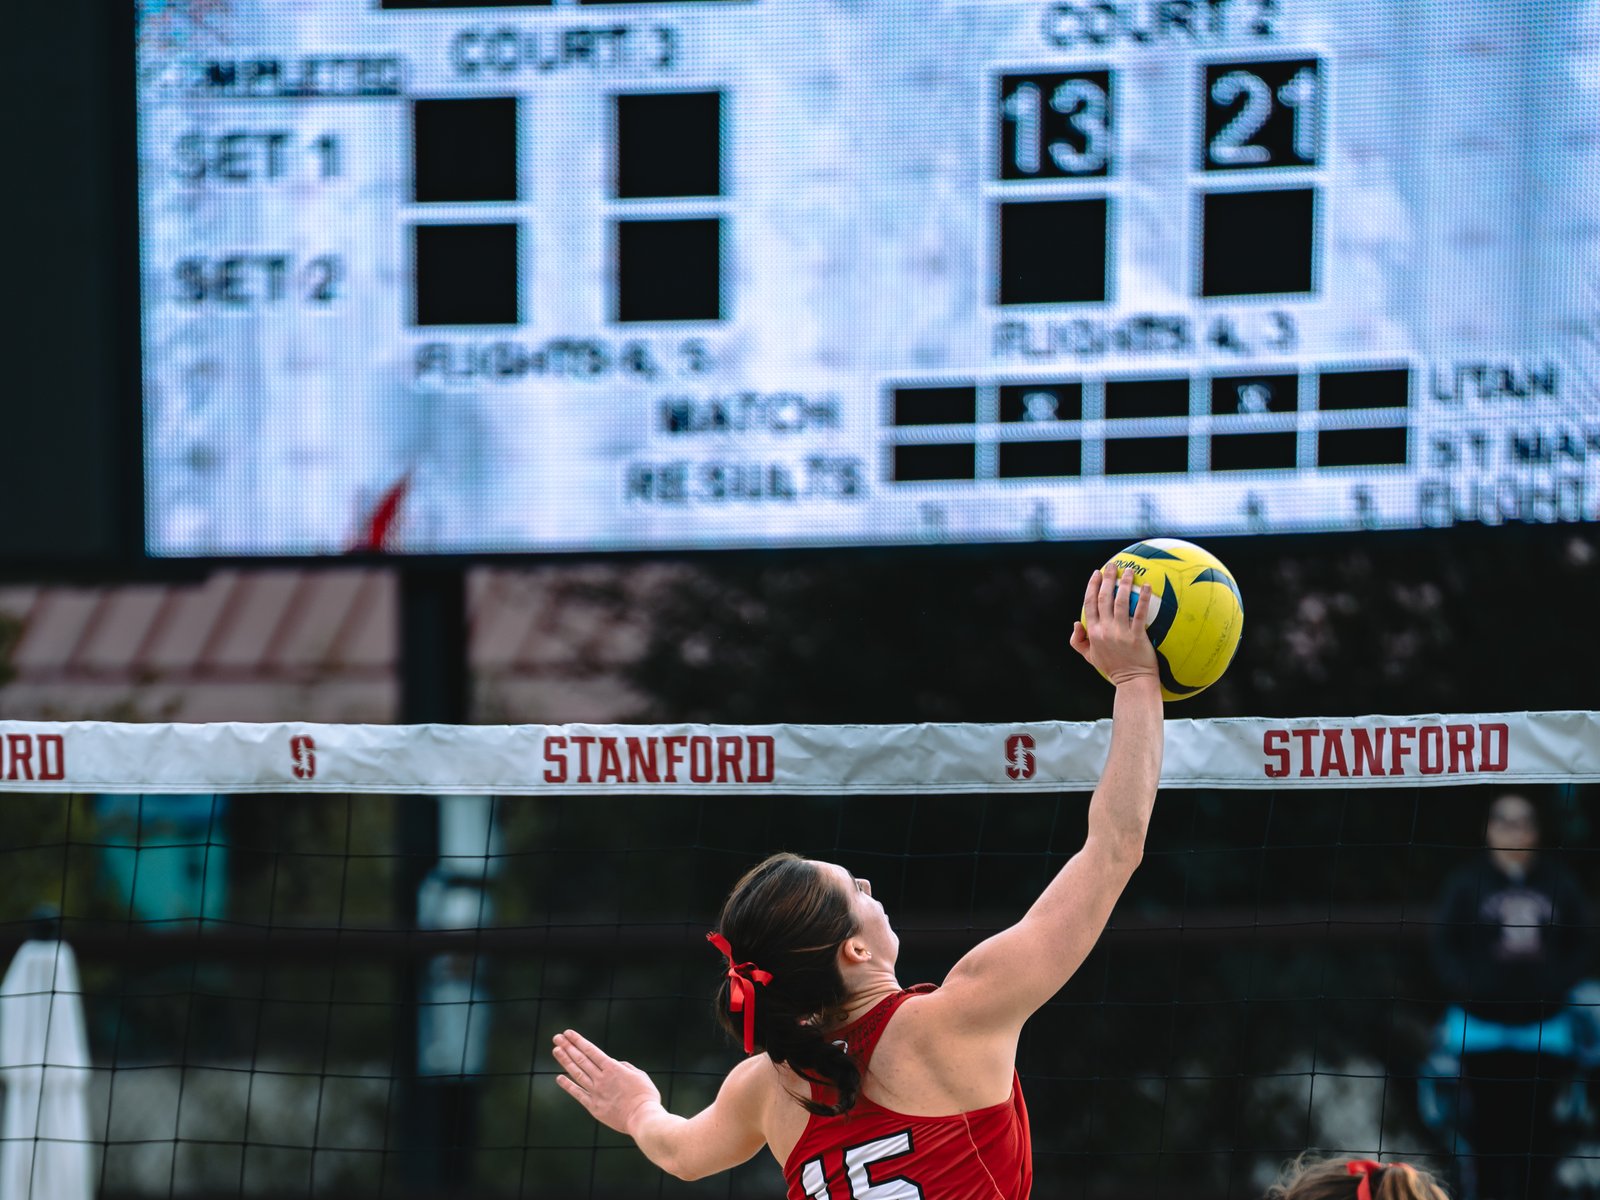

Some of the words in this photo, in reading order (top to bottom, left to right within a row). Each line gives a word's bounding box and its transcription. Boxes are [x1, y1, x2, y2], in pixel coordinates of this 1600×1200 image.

[1042, 0, 1220, 46] COURT
[451, 25, 628, 74] COURT
[1003, 78, 1110, 174] 13
[1208, 67, 1318, 165] 21
[173, 131, 292, 181] SET
[173, 253, 288, 304] SET
[304, 252, 341, 302] 2
[664, 392, 840, 433] MATCH
[542, 734, 776, 784] STANFORD
[1262, 721, 1511, 779] STANFORD
